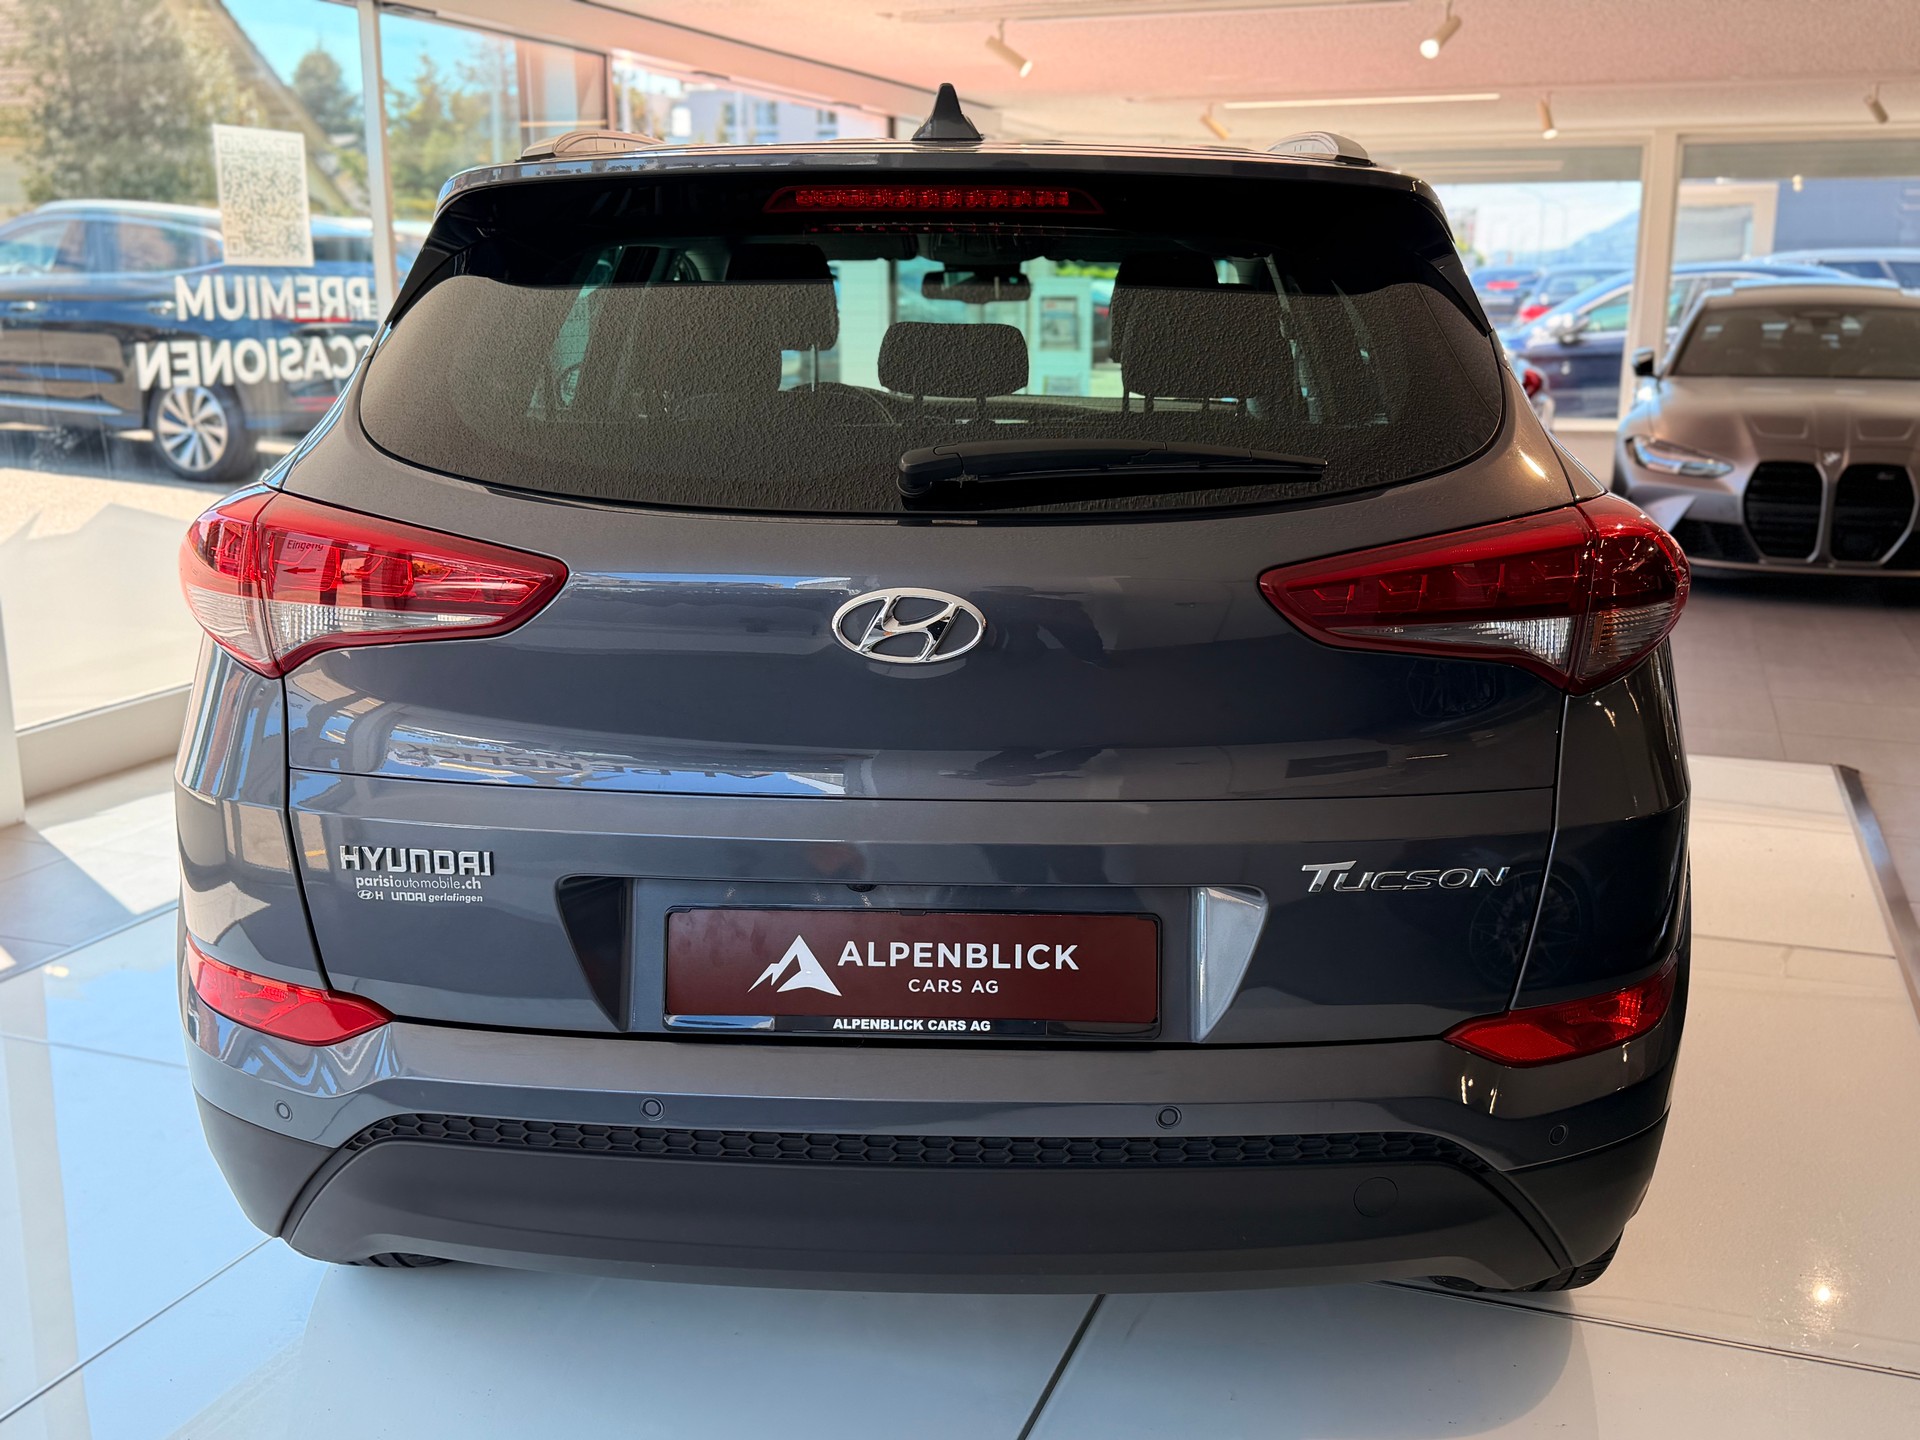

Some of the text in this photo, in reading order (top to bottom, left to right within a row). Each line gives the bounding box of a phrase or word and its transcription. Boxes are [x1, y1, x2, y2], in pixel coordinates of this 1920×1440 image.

[339, 845, 494, 877] HYUNDAI
[356, 875, 482, 890] parisiautomobile.ch
[428, 893, 483, 904] gerlafingen
[837, 940, 1080, 971] ALPENBLICK
[908, 978, 999, 994] CARS AG
[832, 1018, 991, 1032] ALPENBLICK CARS AG
